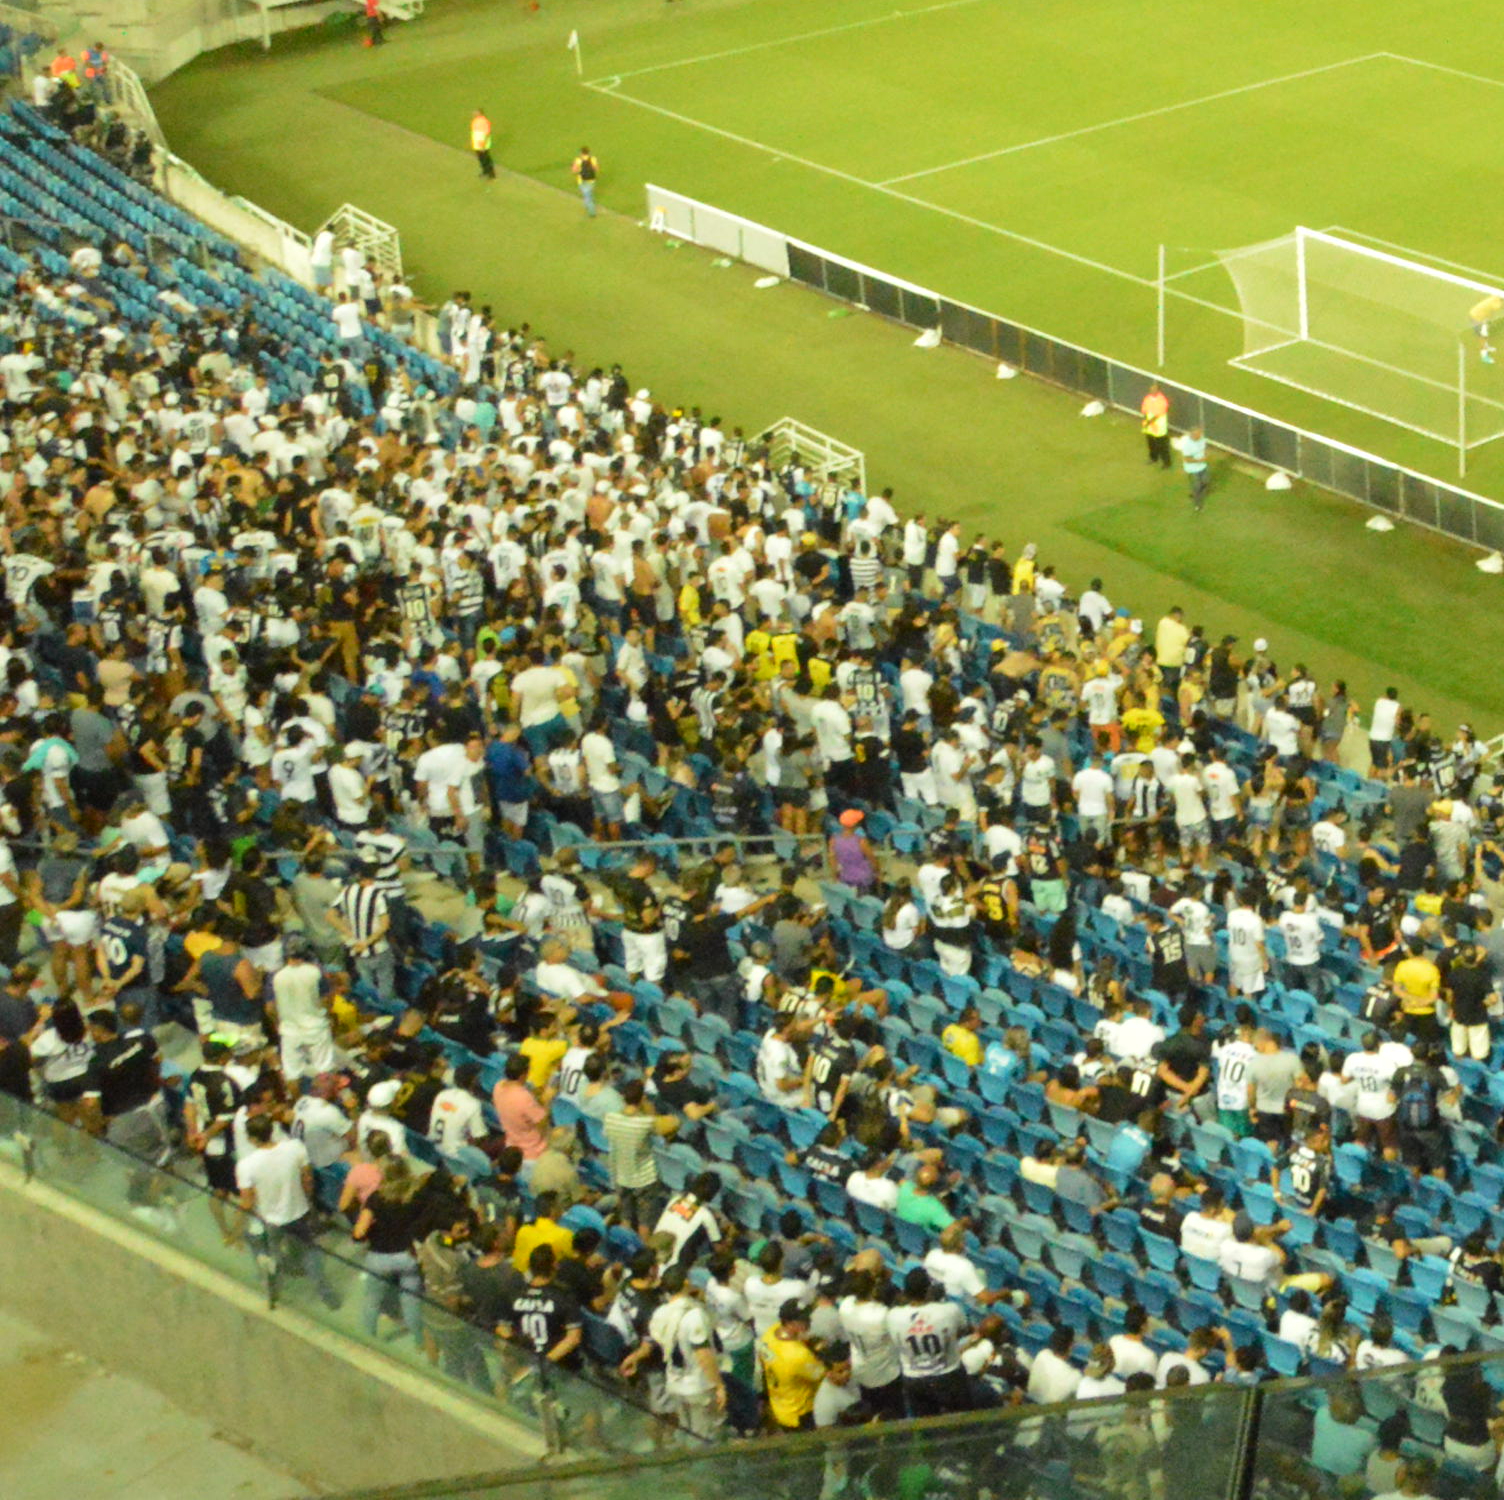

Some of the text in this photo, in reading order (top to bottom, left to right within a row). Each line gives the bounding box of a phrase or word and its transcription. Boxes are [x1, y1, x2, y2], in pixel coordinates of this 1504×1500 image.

[283, 760, 295, 779] 9
[563, 1066, 582, 1095] 10
[812, 1053, 831, 1083] 10
[1223, 1058, 1244, 1084] 10
[1291, 1164, 1310, 1193] 10
[521, 1314, 548, 1345] 10
[906, 1334, 941, 1356] 10
